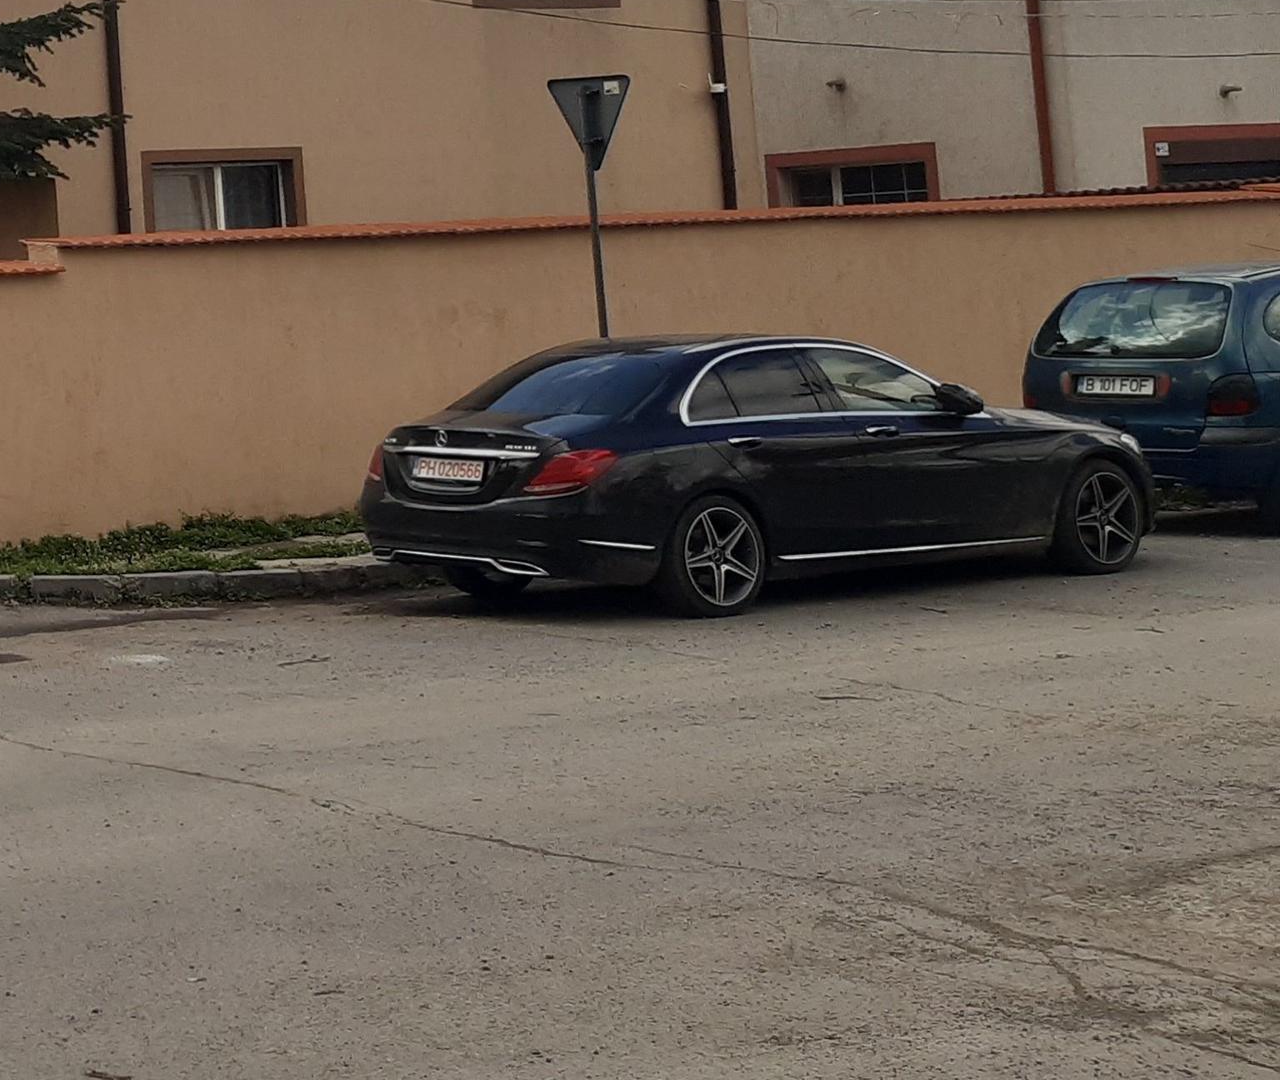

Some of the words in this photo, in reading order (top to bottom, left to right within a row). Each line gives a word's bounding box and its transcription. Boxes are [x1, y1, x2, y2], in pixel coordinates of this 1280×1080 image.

[1086, 377, 1095, 391] B
[1100, 377, 1116, 392] 101
[419, 460, 436, 475] PH
